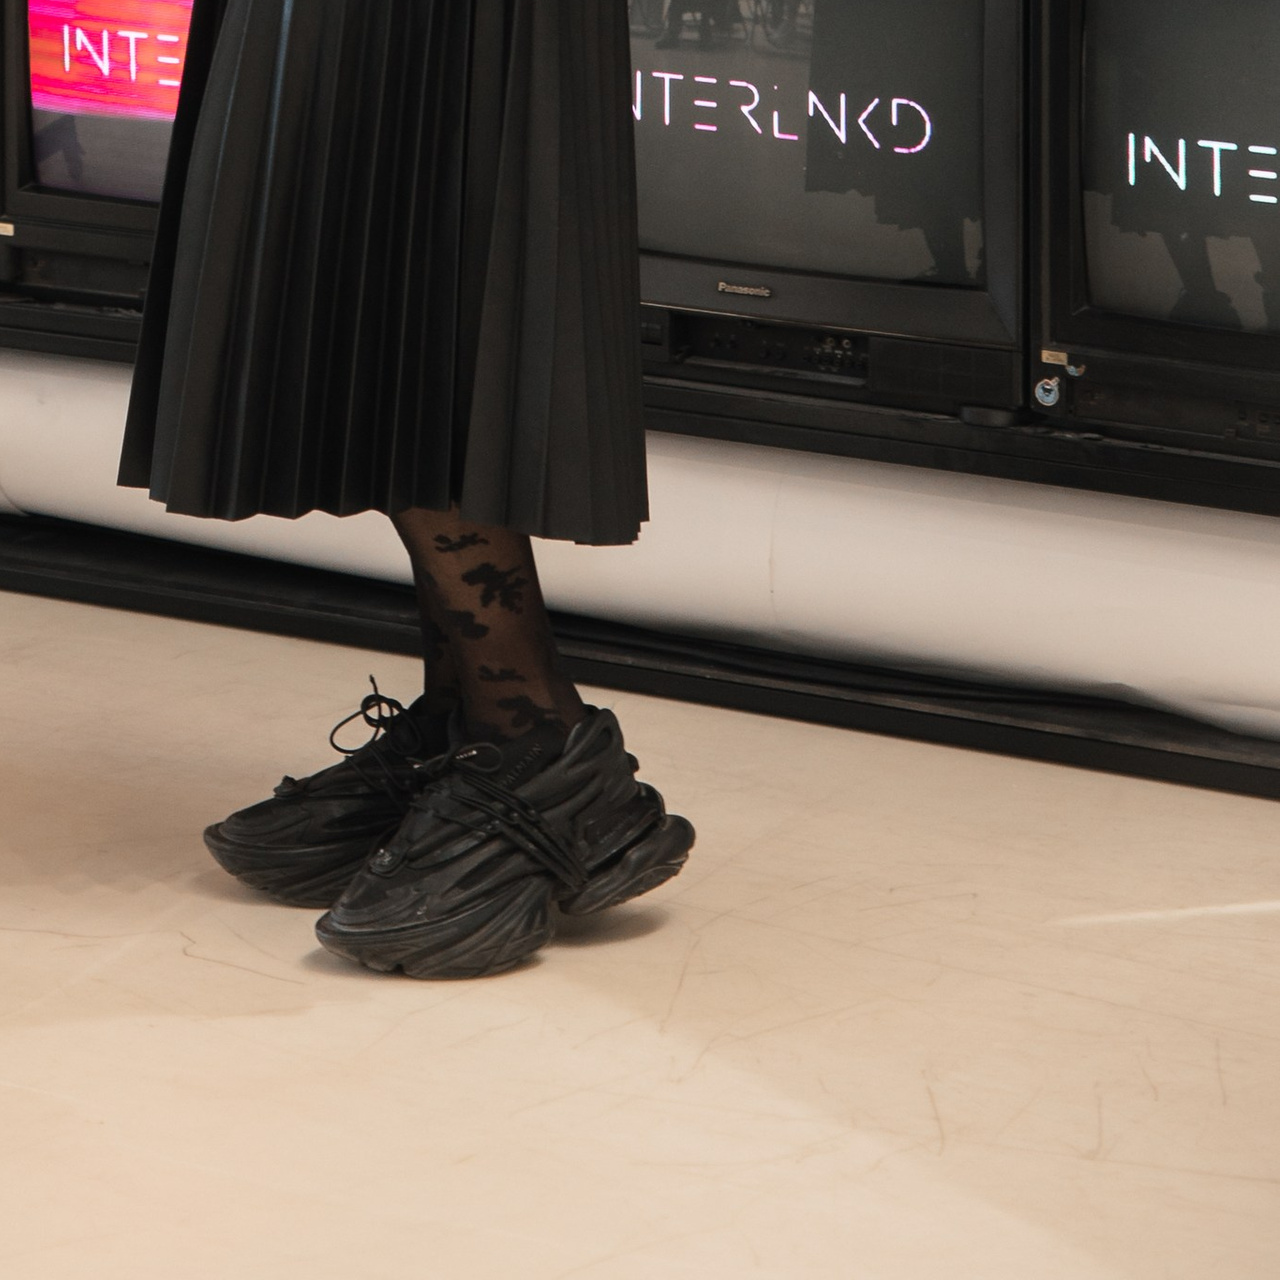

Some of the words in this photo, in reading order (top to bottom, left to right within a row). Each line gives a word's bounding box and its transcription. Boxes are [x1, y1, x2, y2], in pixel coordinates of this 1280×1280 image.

[63, 24, 181, 87] INTE
[1129, 132, 1278, 204] INTE
[718, 281, 770, 297] Panasonic
